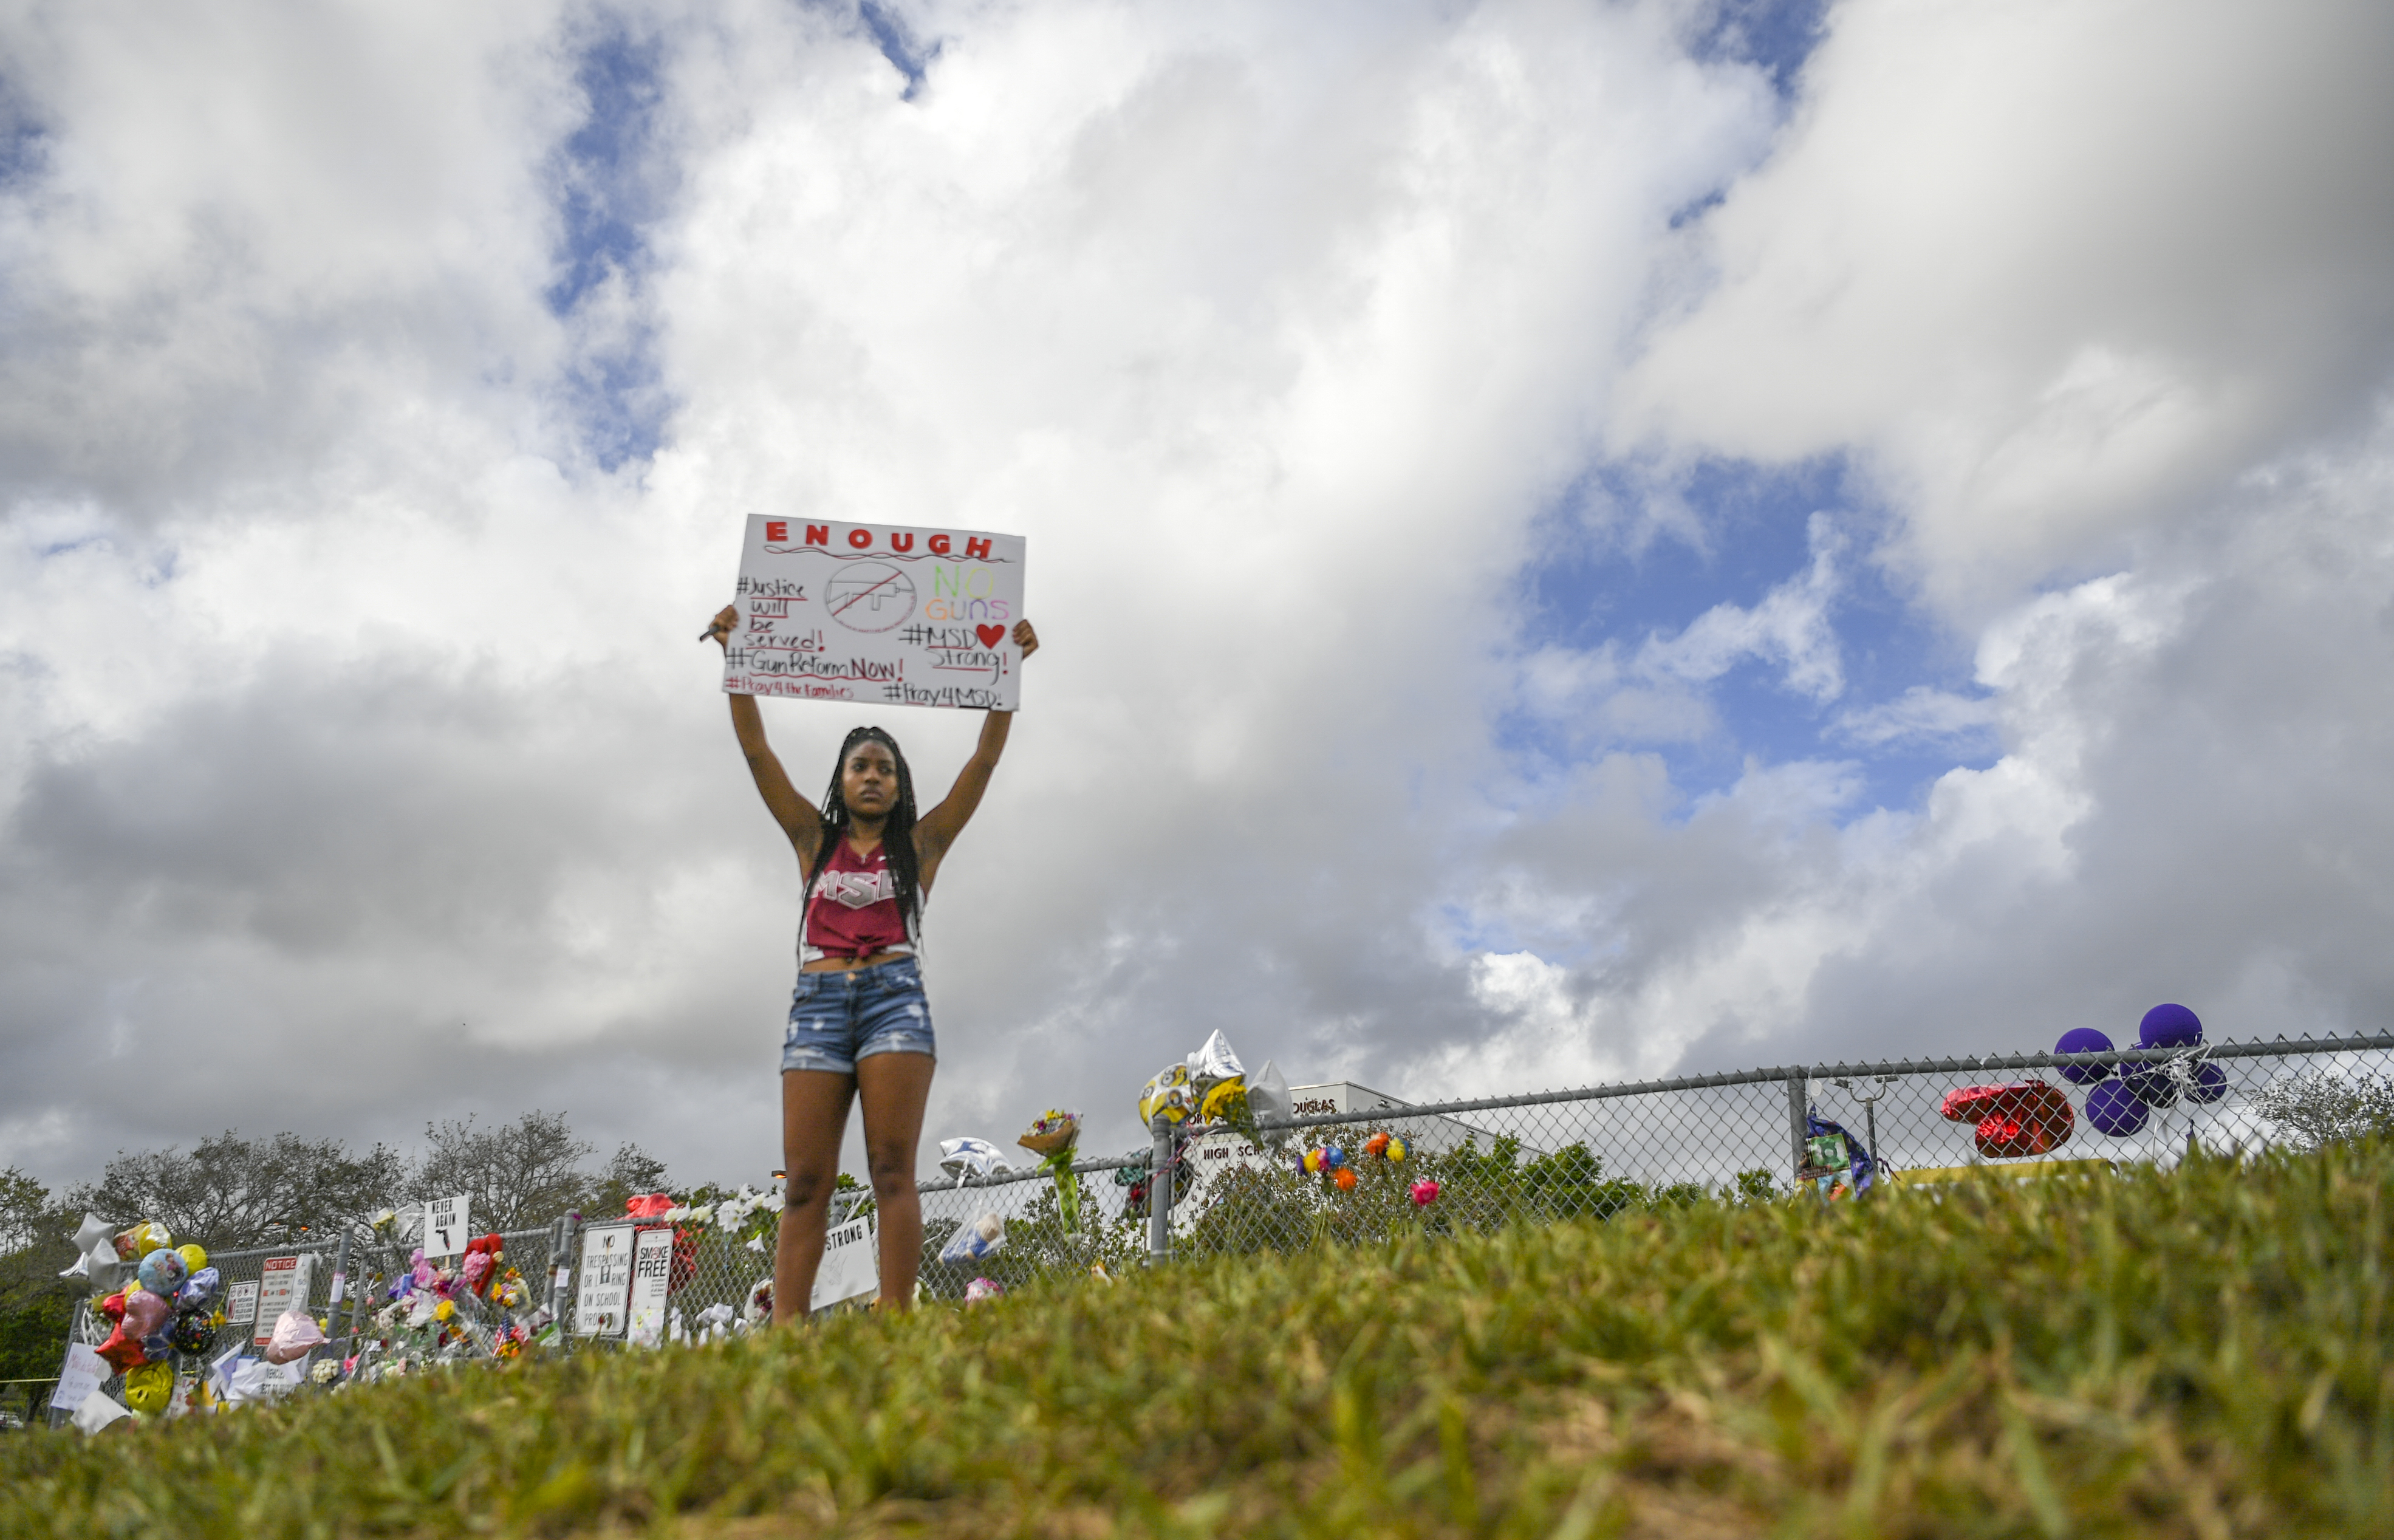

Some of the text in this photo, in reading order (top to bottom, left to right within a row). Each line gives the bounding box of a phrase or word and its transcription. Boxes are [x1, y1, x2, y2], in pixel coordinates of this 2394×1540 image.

[766, 522, 993, 558] ENOUGH
[737, 577, 805, 598] #Justice
[934, 565, 994, 600] NO
[751, 617, 775, 631] be
[898, 624, 979, 649] #MSD
[1293, 1098, 1336, 1114] OUGLAS
[1204, 1145, 1260, 1160] HIGH SCH
[432, 1199, 453, 1214] NEVER
[436, 1213, 456, 1227] AGAIN
[603, 1234, 615, 1248] NO
[826, 1224, 863, 1251] STRONG
[265, 1259, 295, 1270] NOTICE
[586, 1253, 629, 1268] TRESPASSING
[638, 1259, 668, 1278] FREE
[584, 1274, 593, 1287] OR
[595, 1272, 626, 1287] LRING
[584, 1292, 621, 1306] ON SCHOOL
